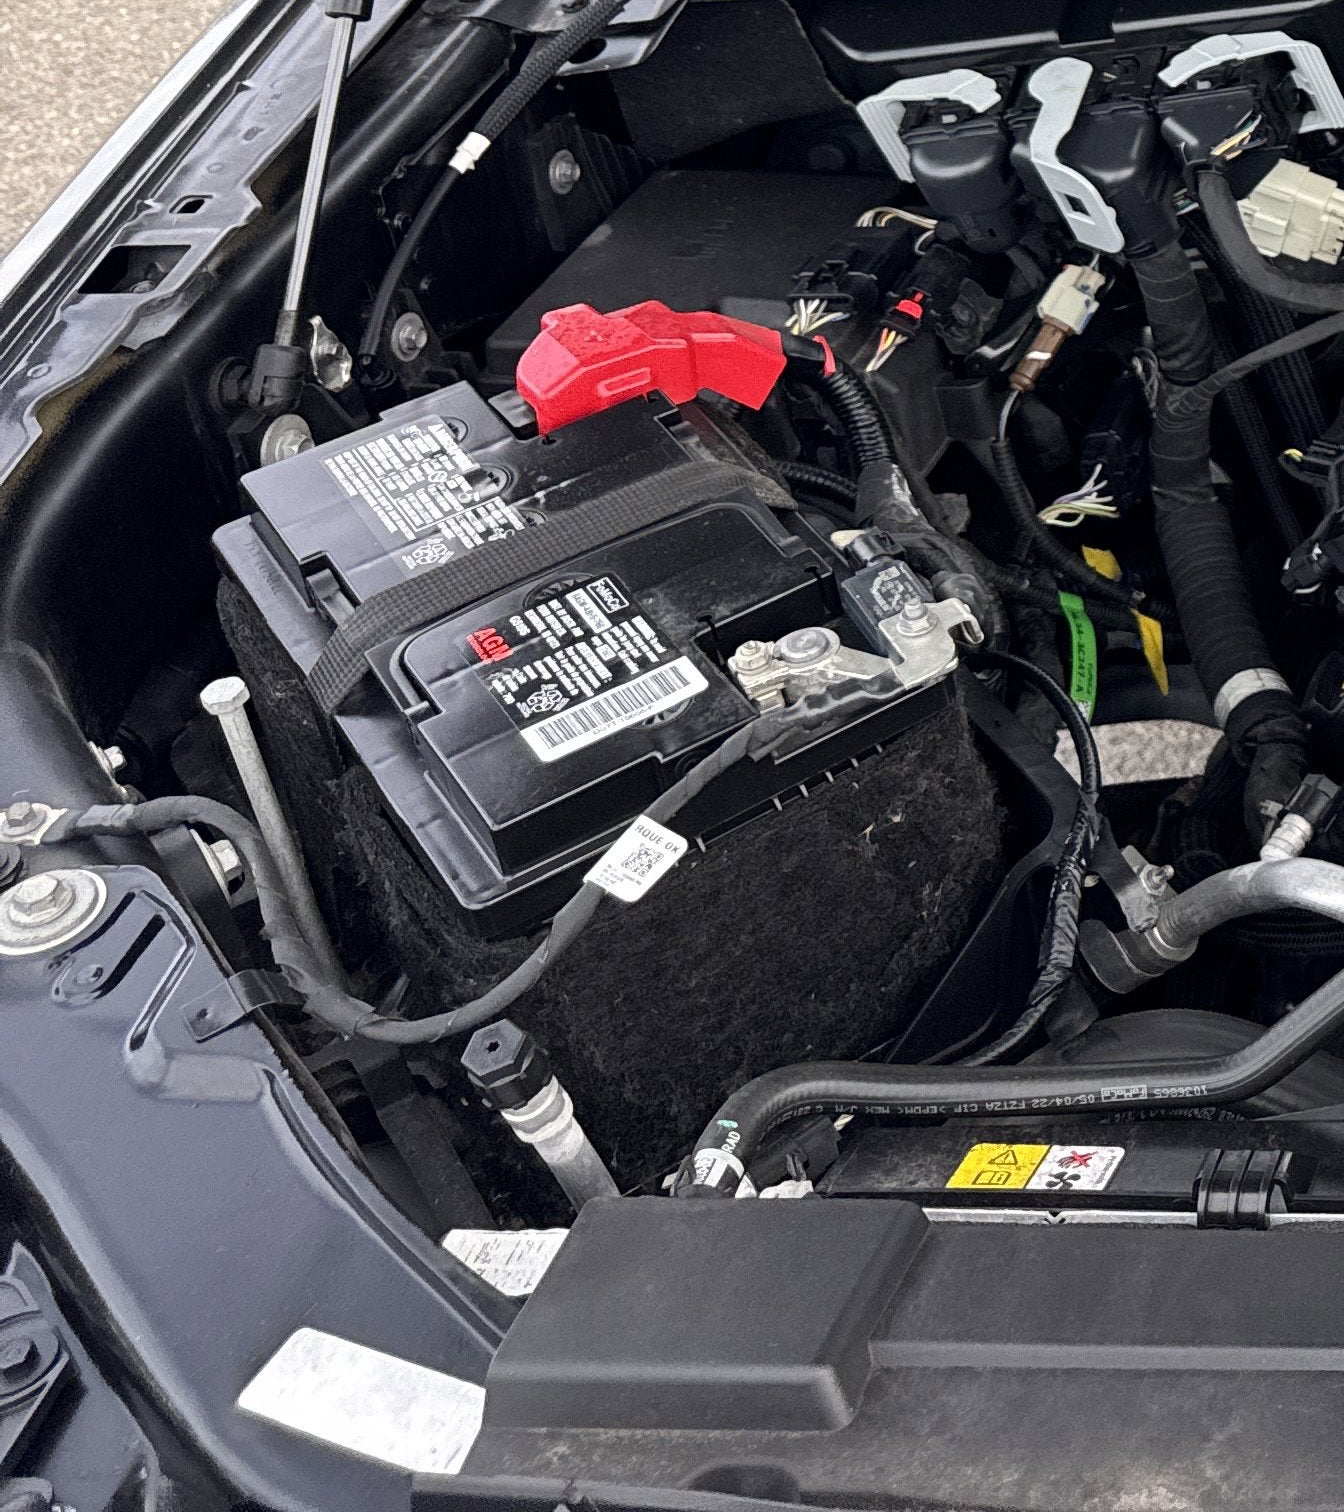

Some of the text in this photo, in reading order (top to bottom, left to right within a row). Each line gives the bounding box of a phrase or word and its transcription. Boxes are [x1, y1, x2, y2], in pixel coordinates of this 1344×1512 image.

[664, 841, 681, 854] OK
[1102, 1086, 1147, 1101] FoMoCo
[1032, 1094, 1095, 1108] 05/04/22
[865, 1104, 890, 1115] MEX
[721, 1131, 741, 1153] RAD
